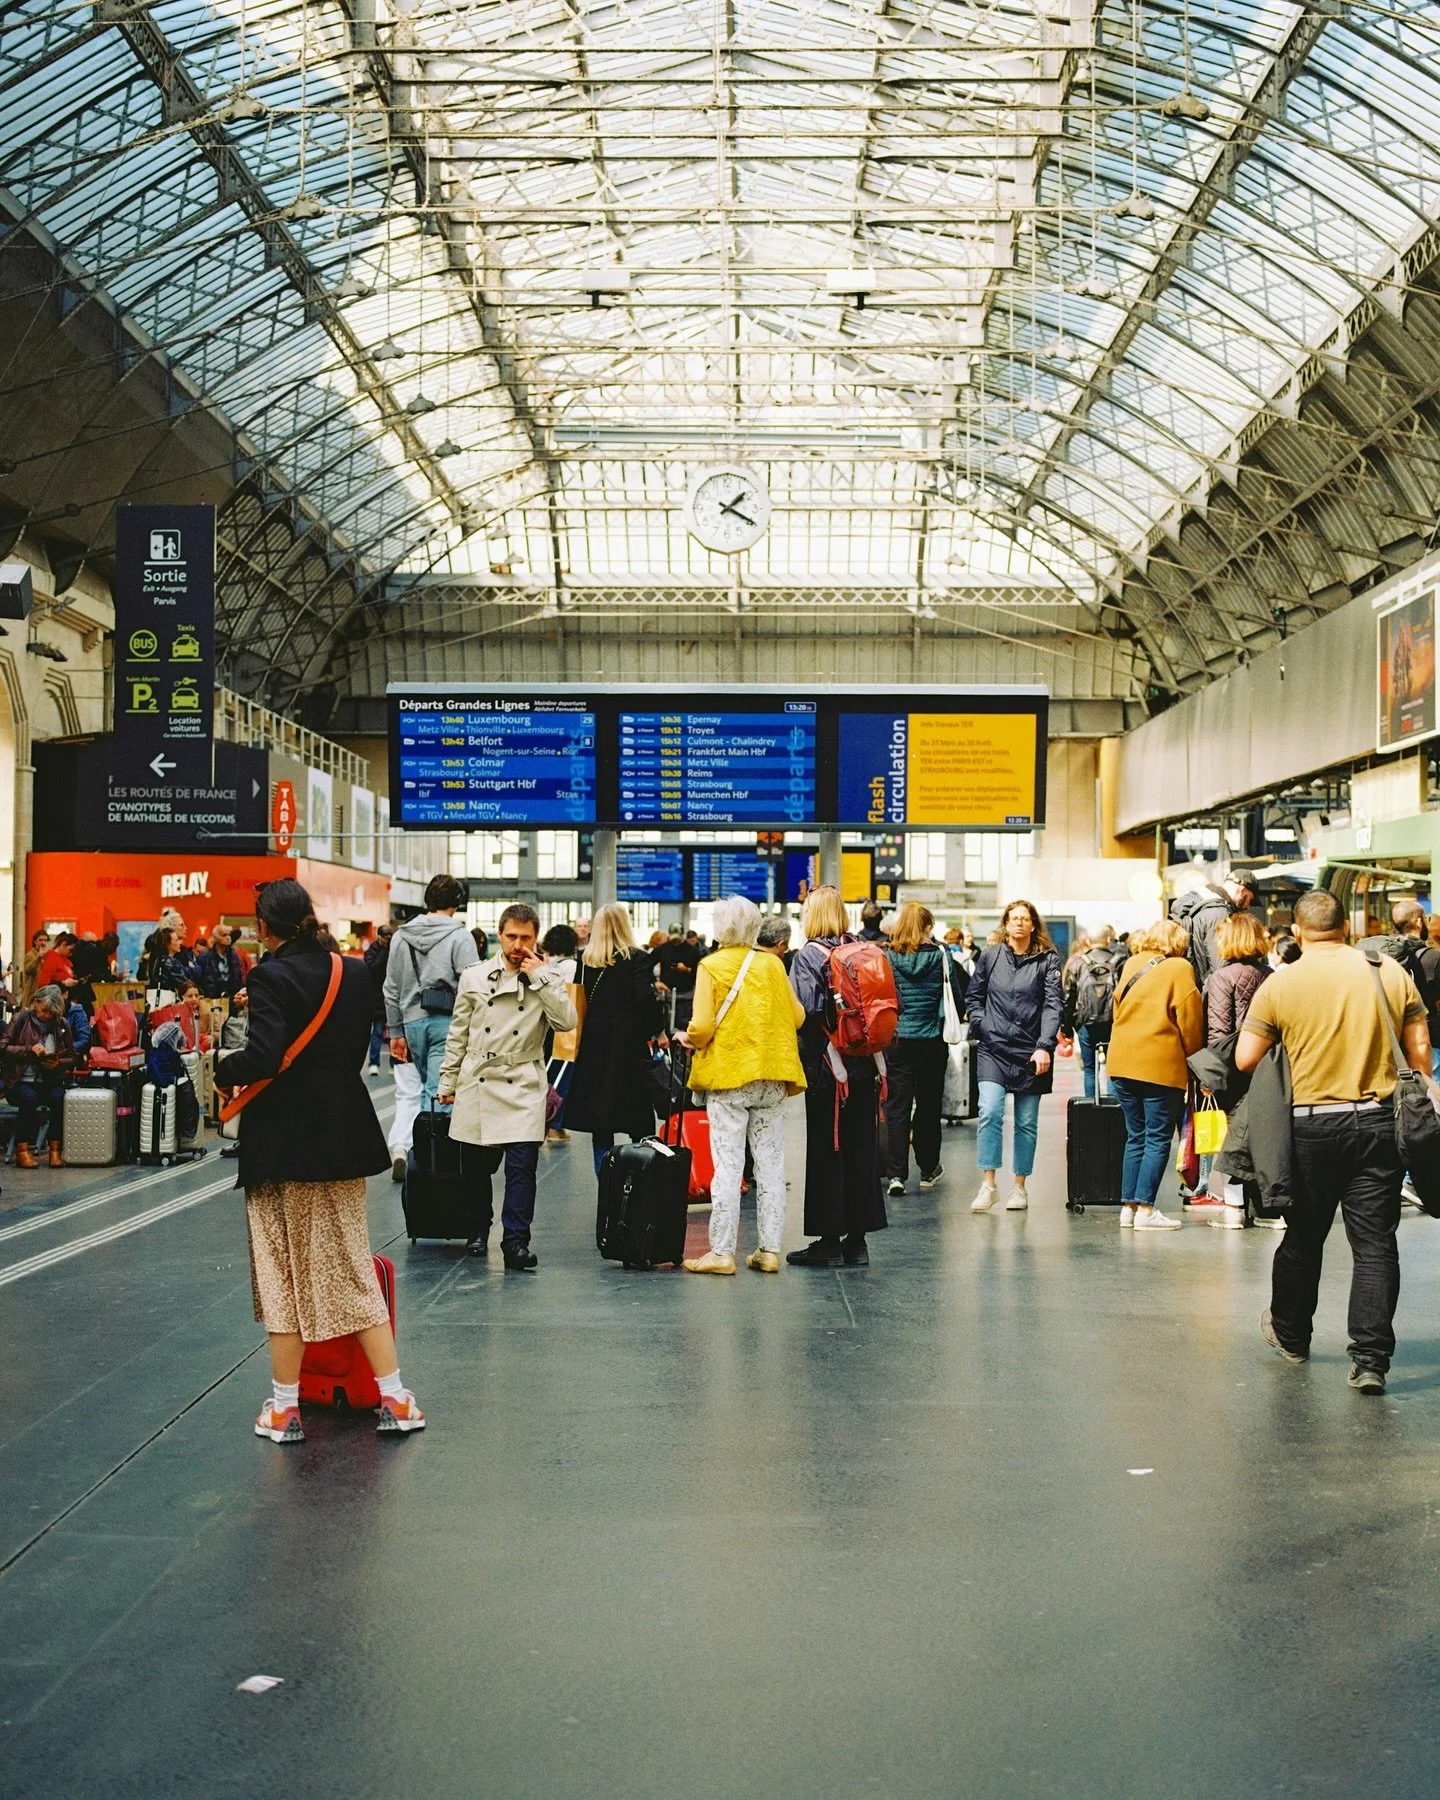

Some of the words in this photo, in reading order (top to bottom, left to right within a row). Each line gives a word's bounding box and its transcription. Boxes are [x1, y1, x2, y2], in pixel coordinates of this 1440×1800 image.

[143, 568, 187, 582] Sortie
[153, 596, 177, 606] Parvis
[177, 624, 195, 632] Taxis
[133, 638, 154, 649] BUS
[399, 699, 444, 713] Départs
[446, 700, 493, 711] Grandes
[494, 700, 531, 713] Lignes
[168, 716, 202, 725] Location
[468, 714, 531, 727] Luxembourg
[687, 714, 721, 726] Epernay
[169, 725, 201, 733] voitures
[418, 725, 440, 734] Metz
[440, 725, 459, 734] Ville
[465, 725, 506, 734] Thionville
[512, 725, 565, 736] Luxembourg
[687, 725, 715, 736] Troyes
[468, 735, 503, 746] Belfort
[687, 736, 724, 746] Culmont
[731, 736, 776, 748] Chalindrey
[482, 746, 556, 757] Nogent-sur-Seine
[687, 747, 726, 757] Frankfurt
[728, 747, 749, 757] Main
[750, 747, 767, 757] Hbf
[468, 756, 506, 768] Colmar
[687, 758, 708, 768] Metz
[710, 758, 729, 768] Ville
[418, 768, 464, 779] Strasbourg
[470, 768, 501, 777] Colmar
[687, 768, 714, 778] Reims
[784, 727, 811, 822] départs
[887, 719, 906, 823] circulation
[468, 778, 515, 791] Stuttgart
[517, 778, 537, 789] Hbf
[687, 779, 733, 791] Strasbourg
[108, 787, 128, 798] LES
[130, 787, 173, 799] ROUTES
[175, 788, 191, 799] DE
[193, 789, 237, 800] FRANCE
[687, 790, 731, 800] Muenchen
[732, 790, 749, 800] Hbf
[867, 776, 886, 823] flash
[107, 802, 172, 813] CYANOTYPES
[469, 799, 501, 812] Nancy
[687, 801, 714, 812] Nancy
[107, 813, 122, 822] DE
[124, 813, 172, 823] MATHILDE
[174, 814, 188, 823] DE
[190, 814, 237, 824] L'ECOTAIS
[280, 787, 290, 846] TABAC
[427, 811, 444, 820] TGV
[449, 811, 475, 820] Meuse
[477, 811, 496, 820] TGV
[501, 811, 528, 822] Nancy
[687, 811, 733, 822] Strasbourg
